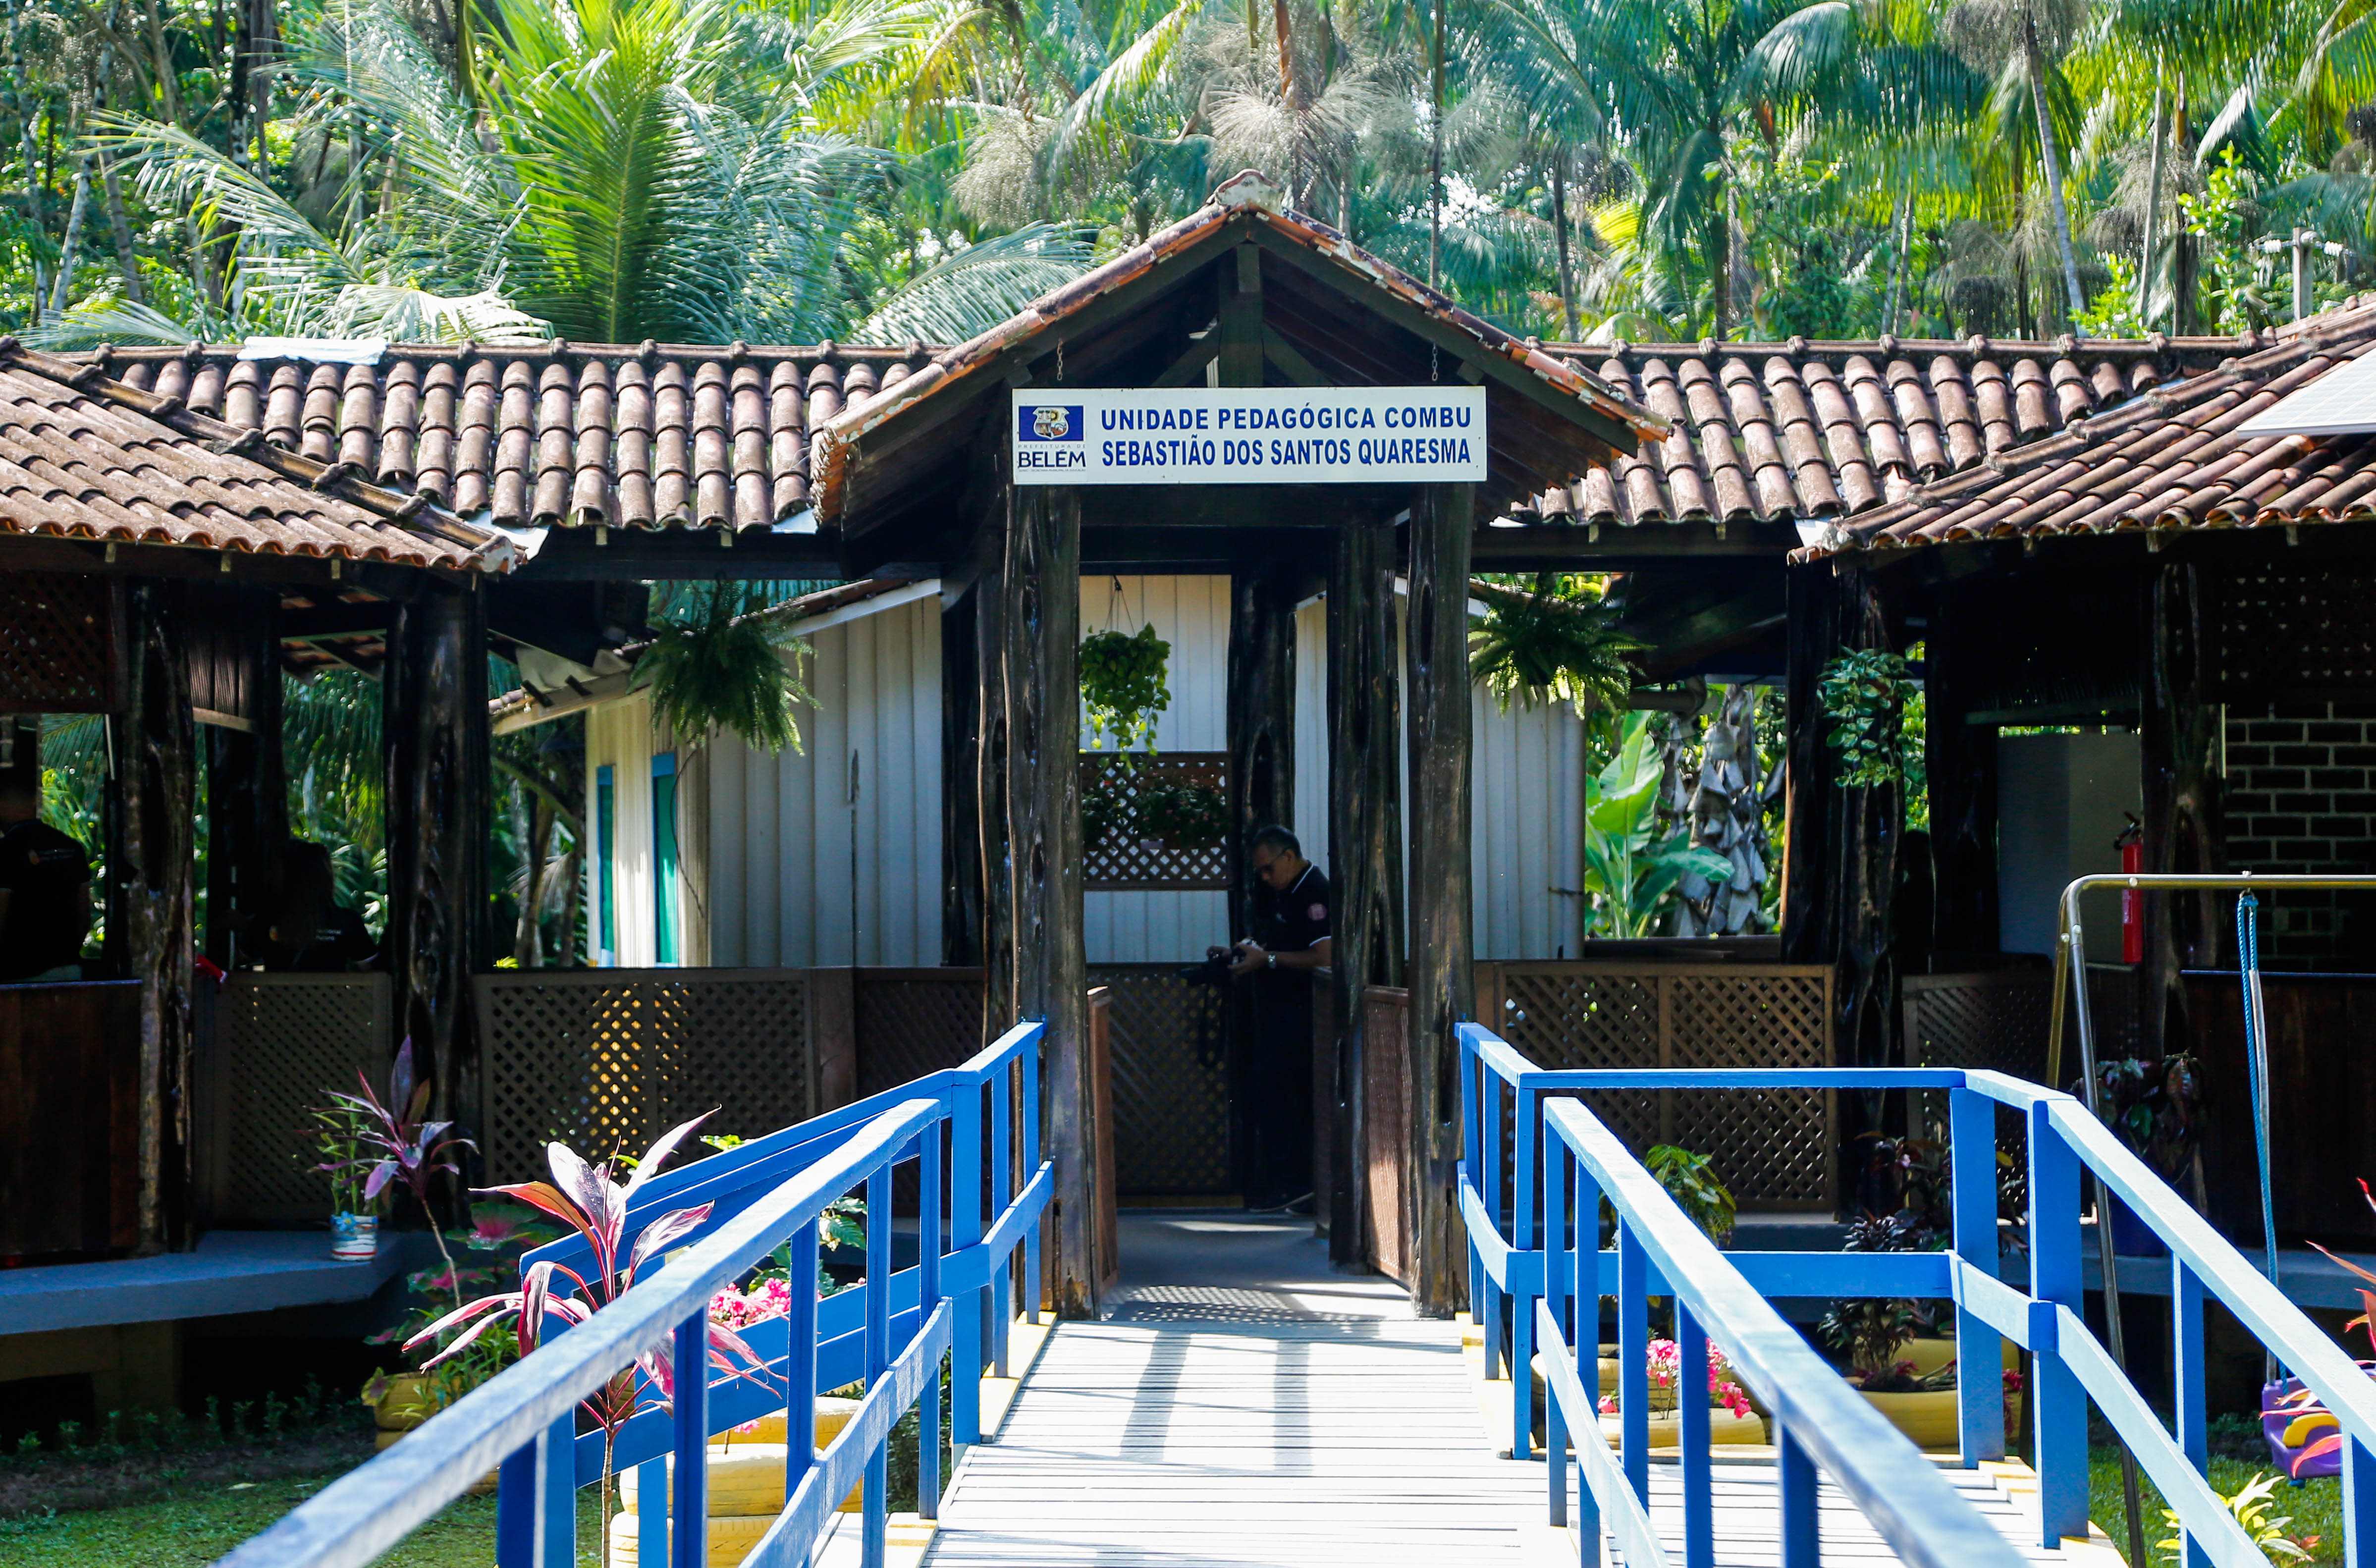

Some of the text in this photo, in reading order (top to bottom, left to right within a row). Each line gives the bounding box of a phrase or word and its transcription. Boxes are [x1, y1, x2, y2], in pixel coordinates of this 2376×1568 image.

[1101, 402, 1471, 431] UNIDADE PEDAGÓGICA COMBU
[1018, 449, 1086, 468] BELÉM
[1101, 434, 1471, 467] SEBASTIÃO DOS SANTOS QUARESMA
